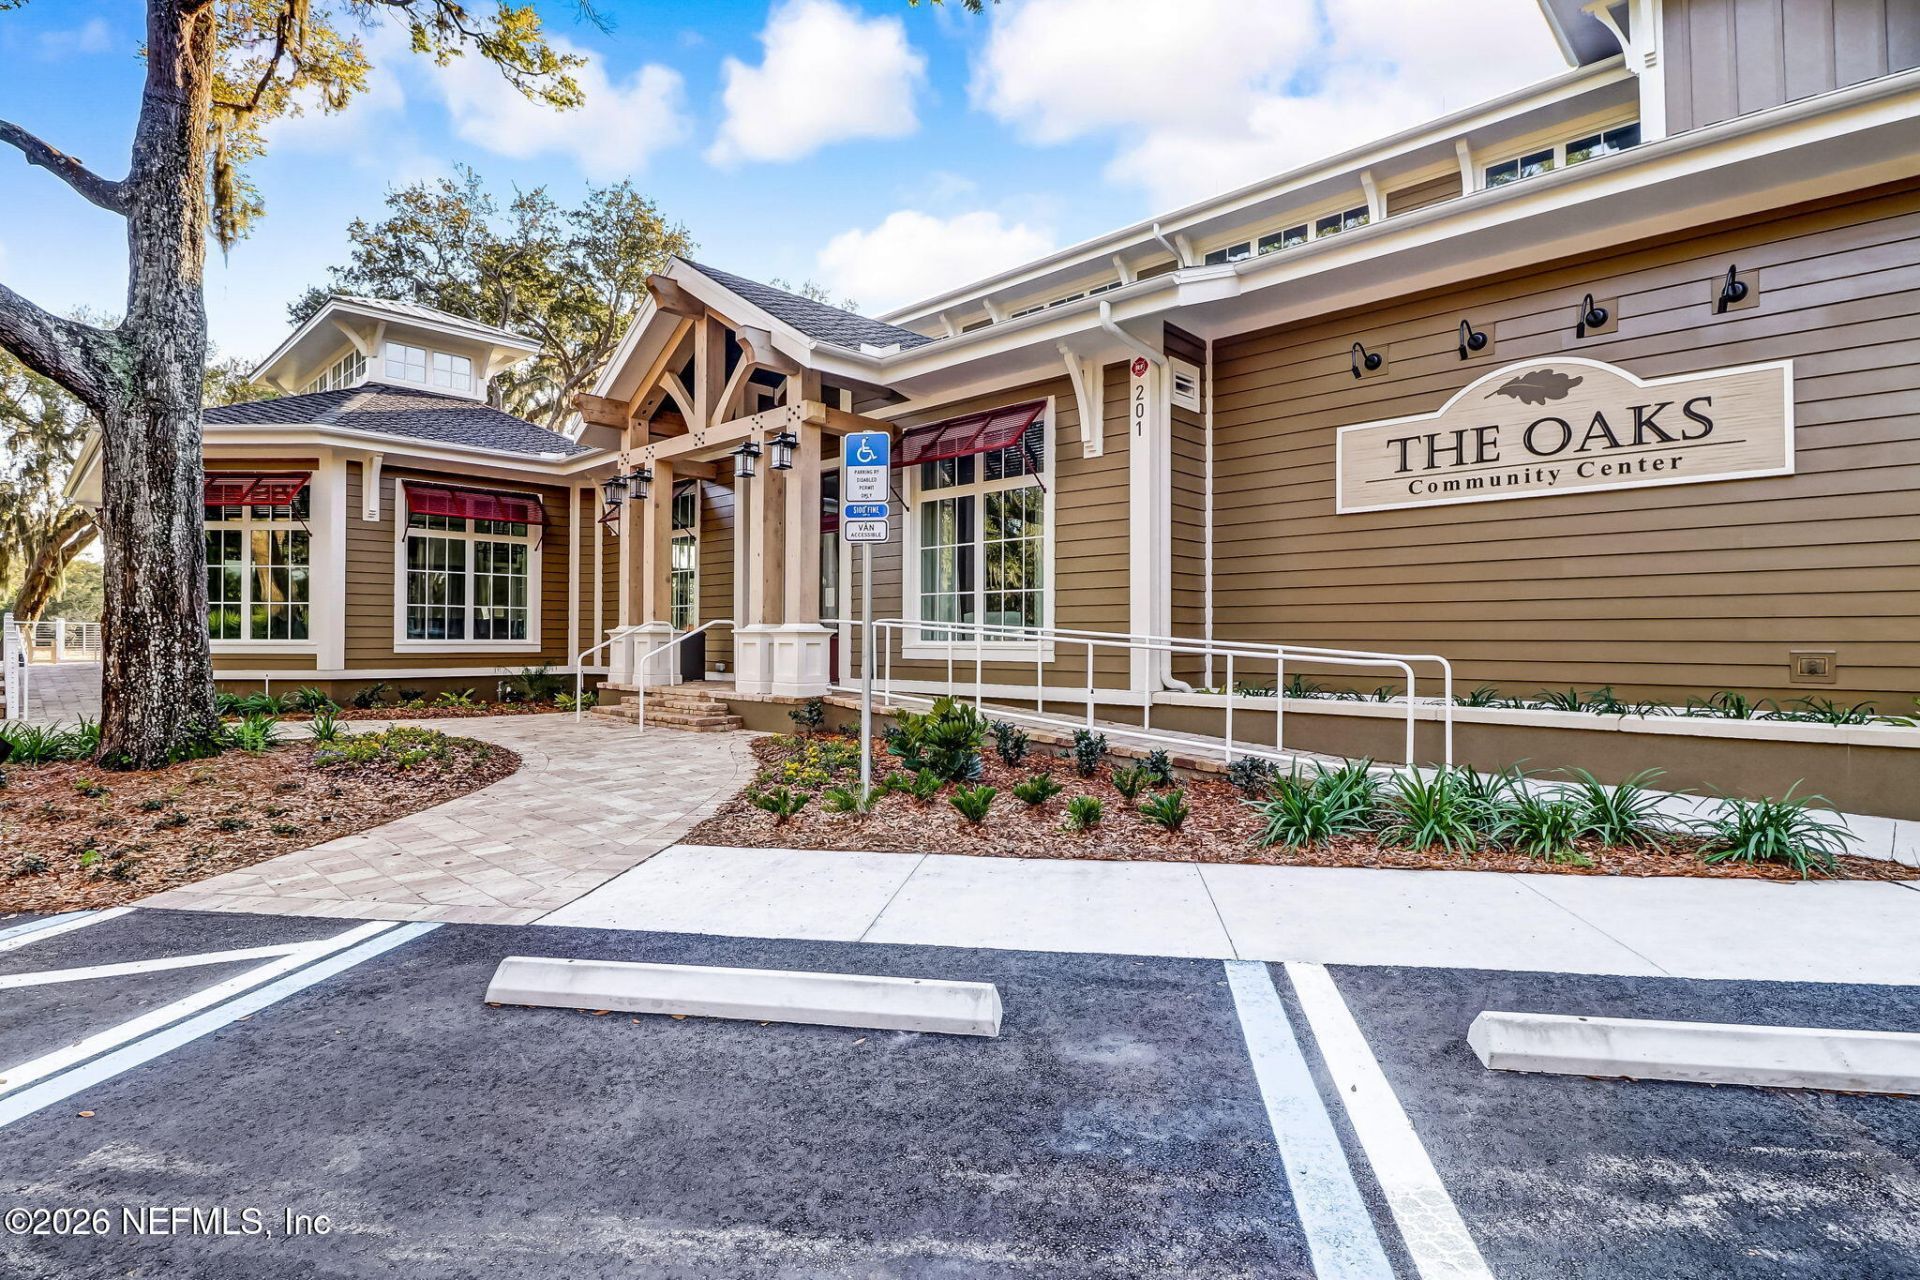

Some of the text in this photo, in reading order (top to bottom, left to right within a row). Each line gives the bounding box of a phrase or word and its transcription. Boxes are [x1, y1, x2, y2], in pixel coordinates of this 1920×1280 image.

[1136, 384, 1144, 436] 201
[1386, 396, 1714, 474] THE OAKS
[1408, 456, 1683, 495] Community Center
